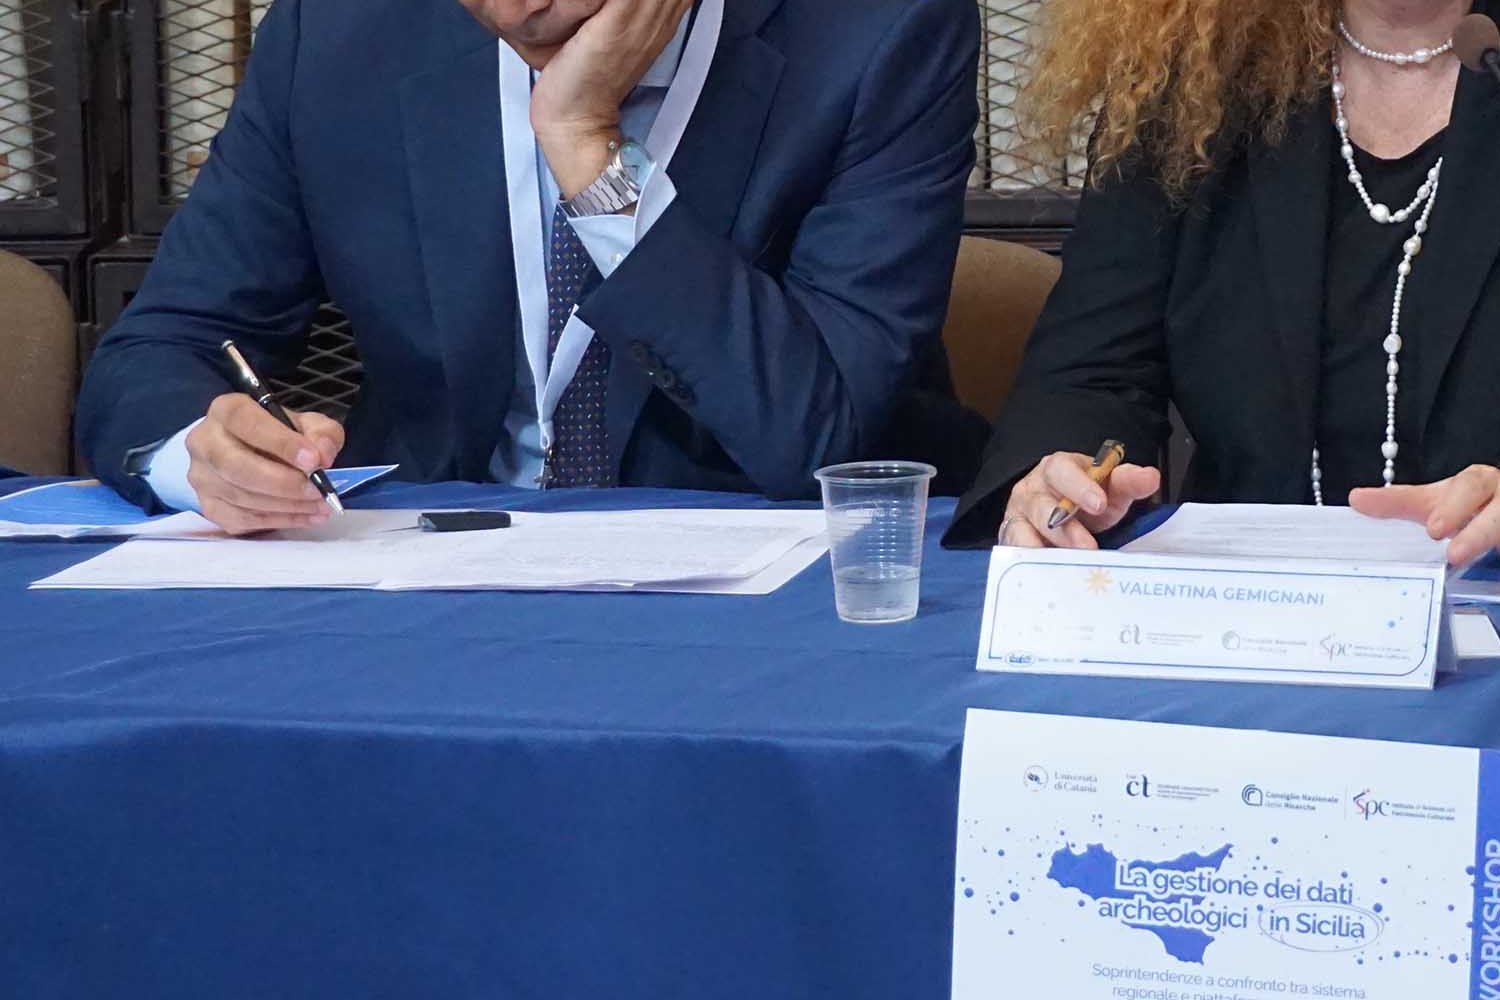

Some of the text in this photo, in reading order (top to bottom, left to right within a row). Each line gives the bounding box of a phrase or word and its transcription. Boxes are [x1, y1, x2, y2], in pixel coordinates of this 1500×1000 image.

[1119, 581, 1325, 606] VALENTINA GEMIGNANI
[1119, 865, 1353, 904] La gestione dei dati
[1099, 899, 1365, 938] archeologici in Sicilia
[1092, 963, 1366, 999] Soprintendenze a confronto tra sistema
